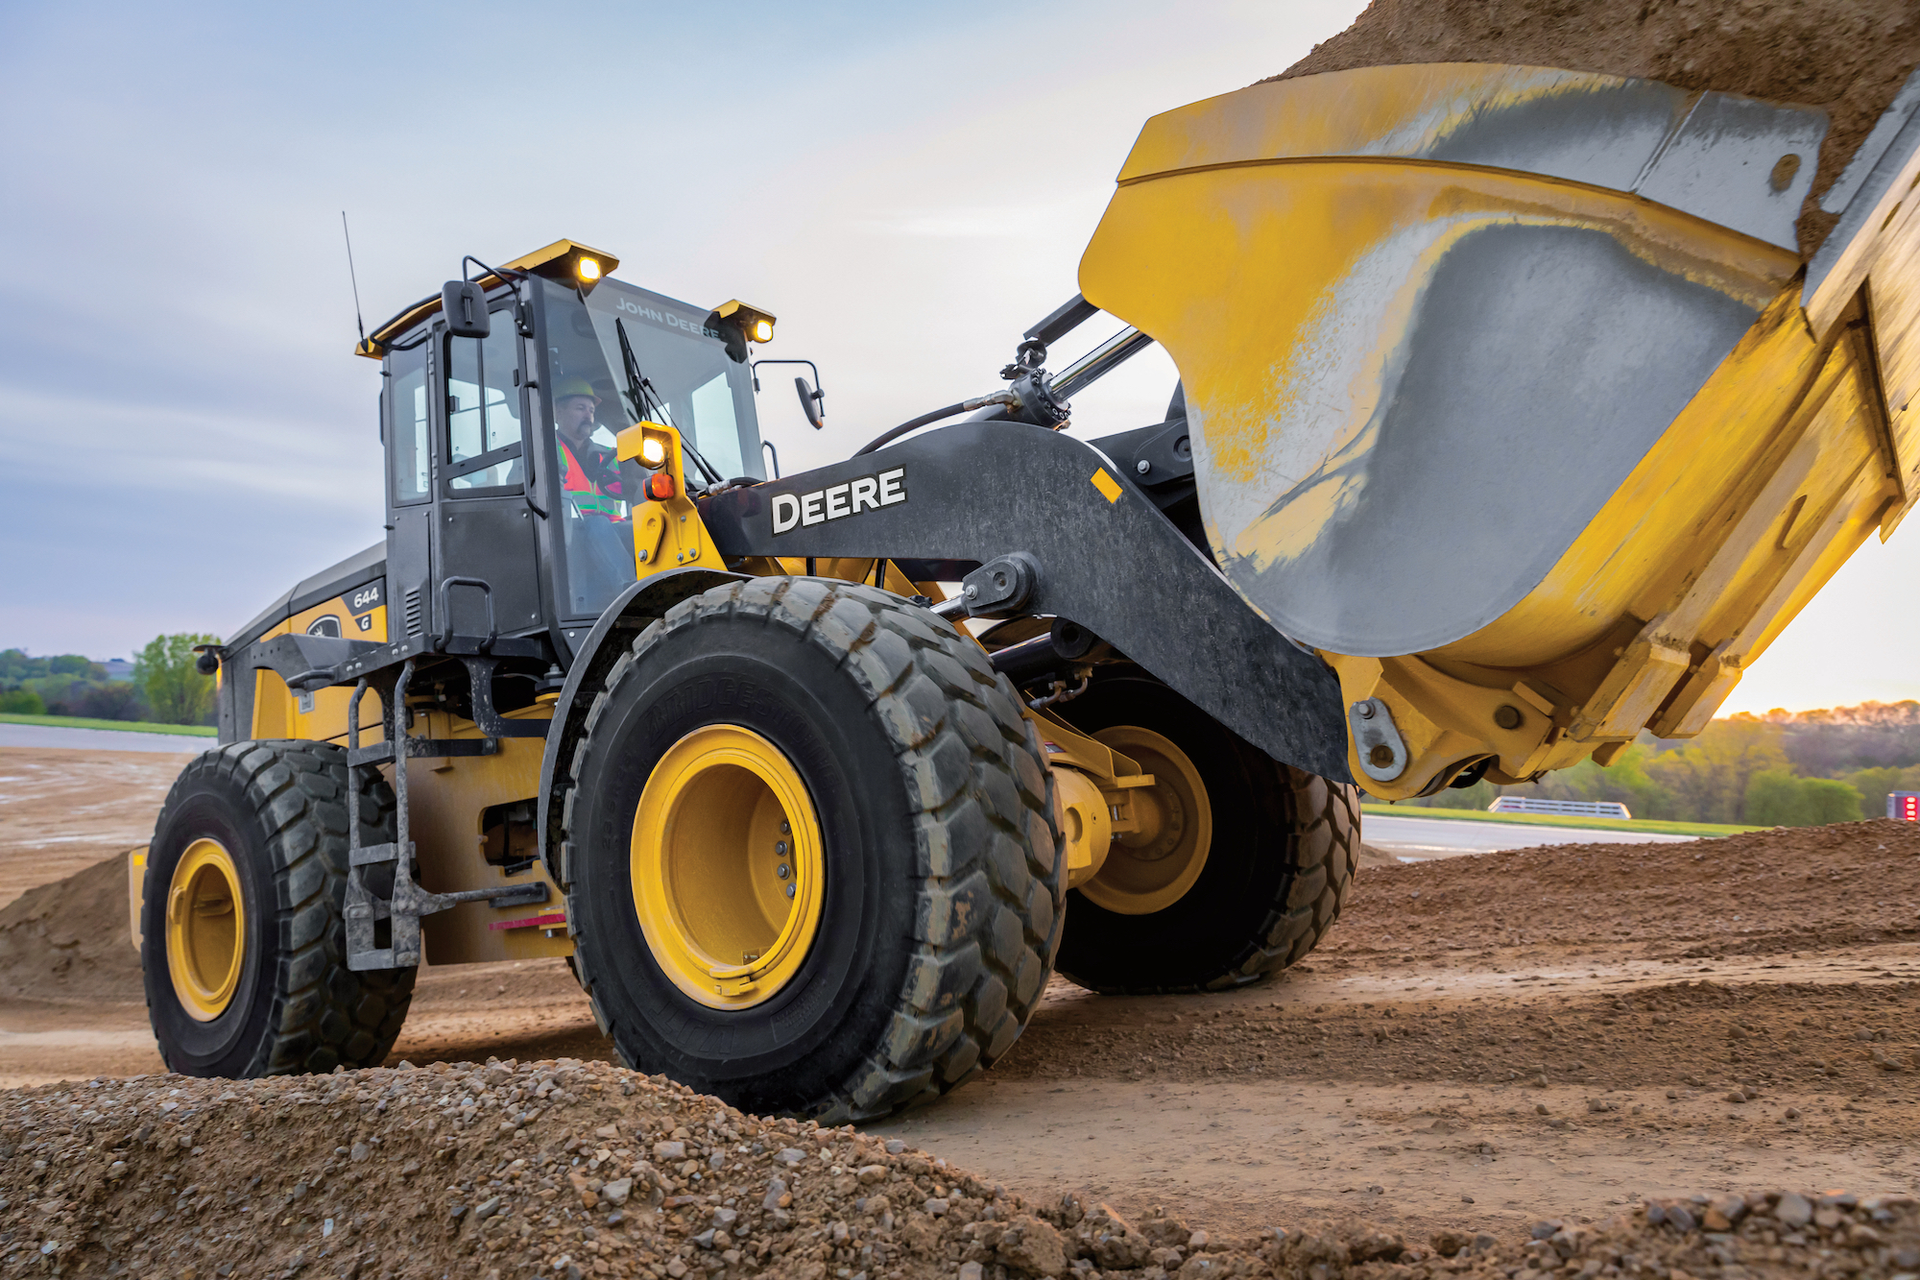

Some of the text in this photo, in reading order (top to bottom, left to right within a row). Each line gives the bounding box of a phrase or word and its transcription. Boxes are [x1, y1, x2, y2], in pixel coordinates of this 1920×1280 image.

[616, 297, 721, 341] JOHN DEERE
[772, 467, 906, 534] DEERE
[353, 586, 379, 608] 644
[361, 616, 370, 630] G
[639, 676, 842, 793] BRIDGESTONE
